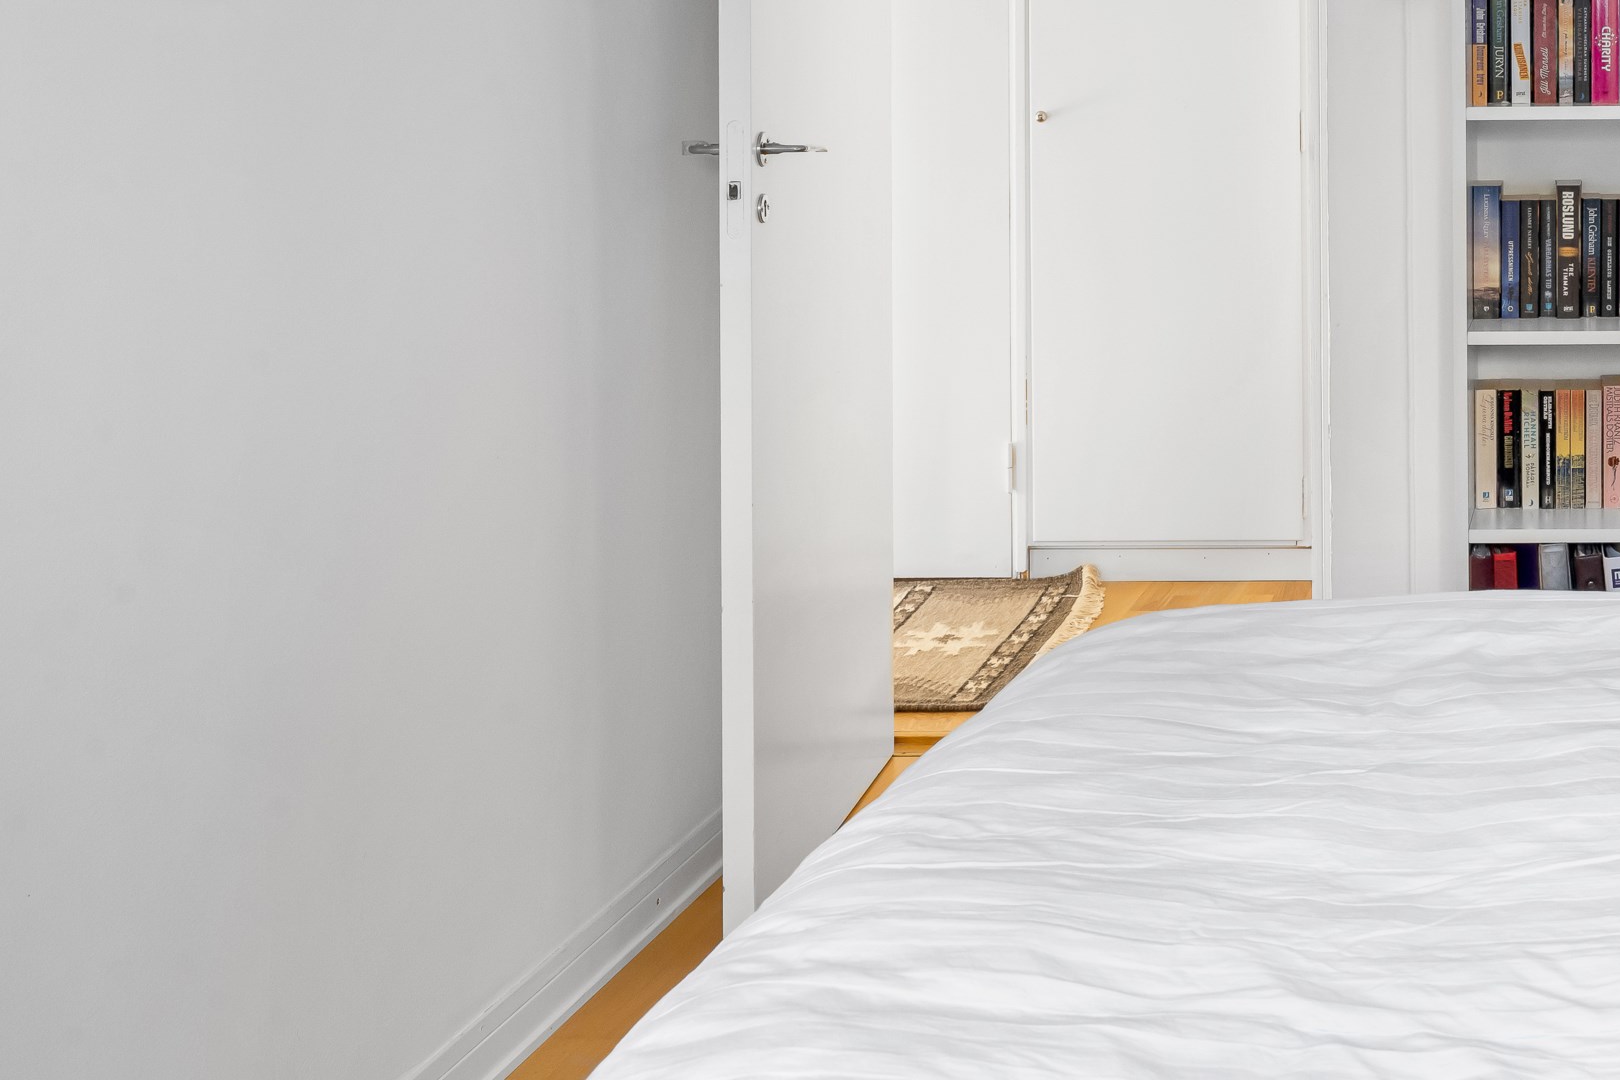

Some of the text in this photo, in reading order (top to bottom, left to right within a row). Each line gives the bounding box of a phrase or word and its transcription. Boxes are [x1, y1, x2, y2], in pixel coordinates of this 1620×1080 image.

[1476, 8, 1485, 43] John Grisham
[1494, 45, 1504, 78] JURYN
[1601, 26, 1611, 71] CHARITY
[1562, 191, 1574, 239] ROSLUND
[1587, 207, 1597, 292] John Grisham KLIENTEN
[1606, 387, 1614, 422] MISTRALS
